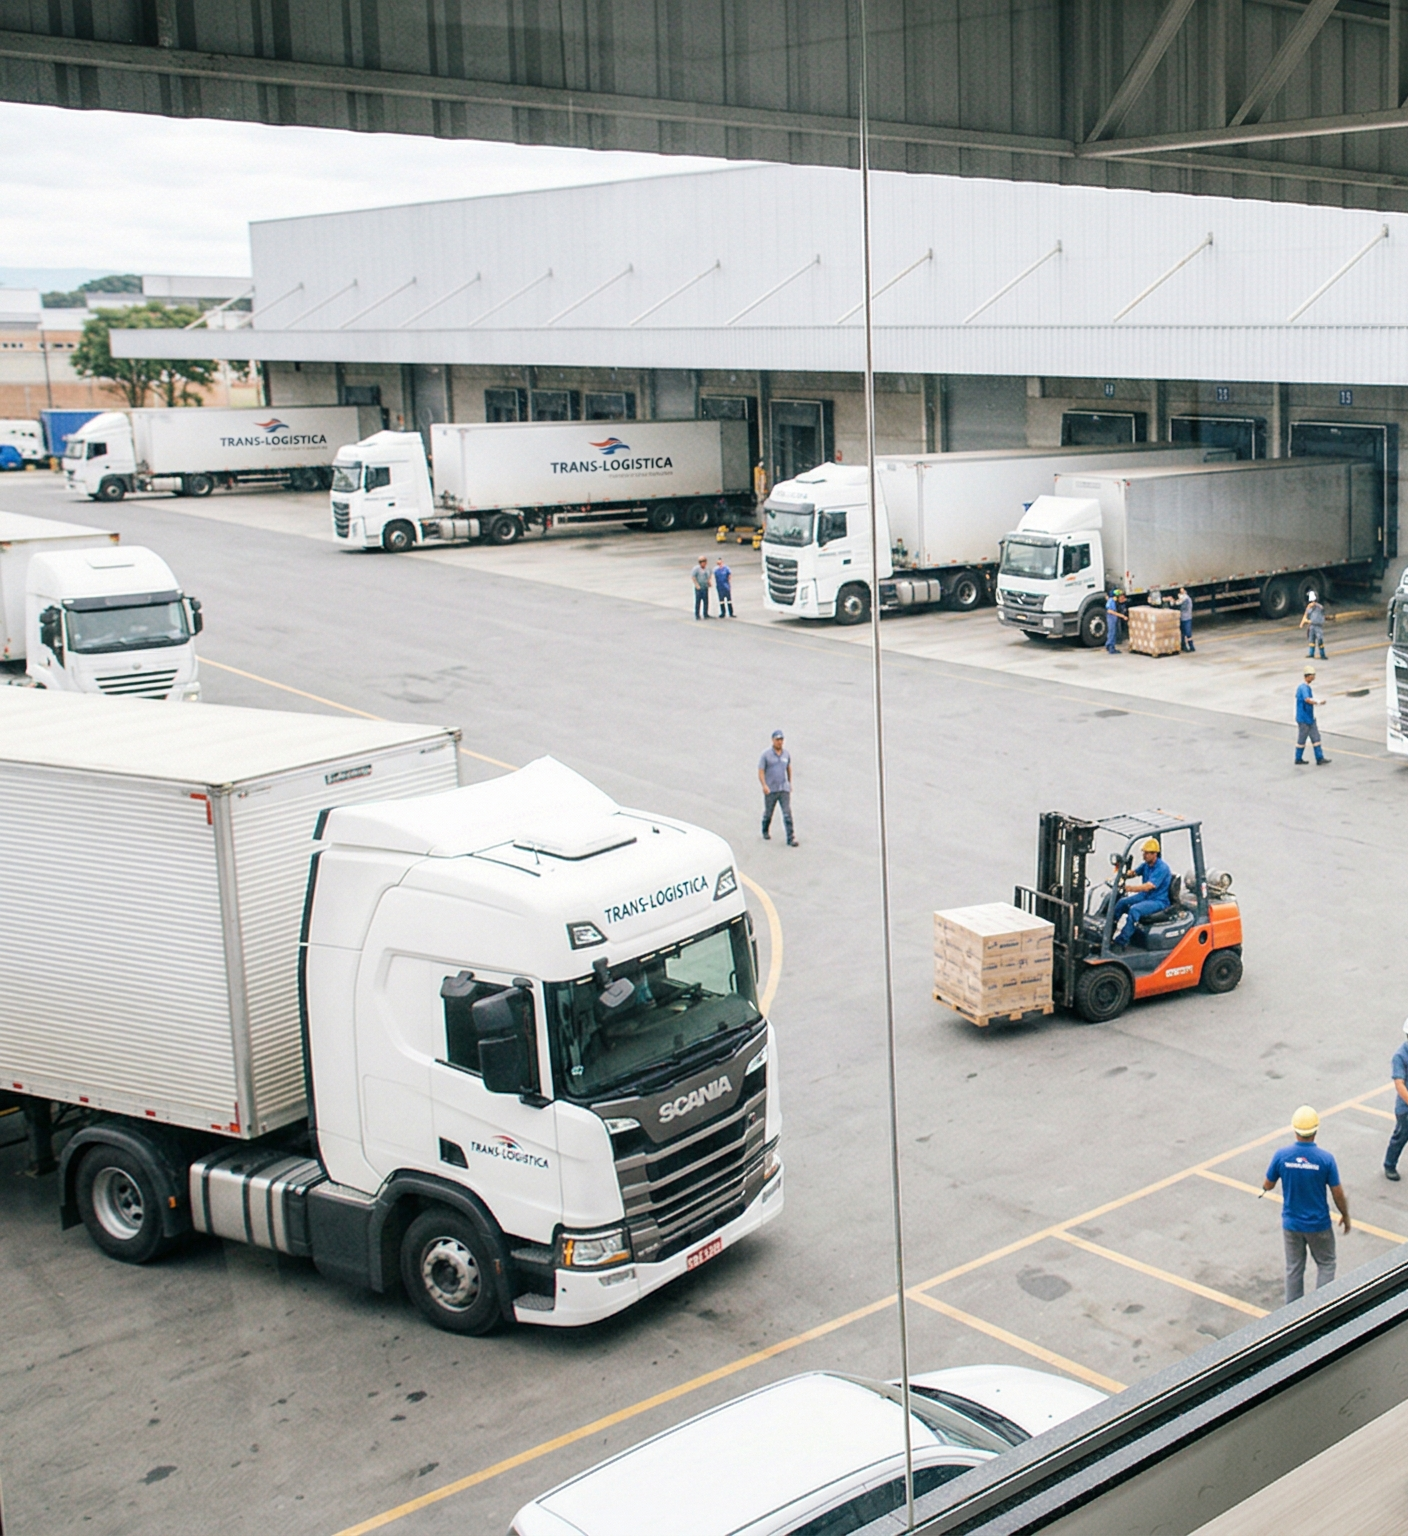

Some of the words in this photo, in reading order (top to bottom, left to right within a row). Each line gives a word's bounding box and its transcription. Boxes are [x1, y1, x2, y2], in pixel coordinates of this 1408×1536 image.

[220, 434, 327, 448] TRANS-LOGISTICA
[550, 456, 674, 475] TRANS-LOGISTICA
[659, 1075, 733, 1123] SCANIA
